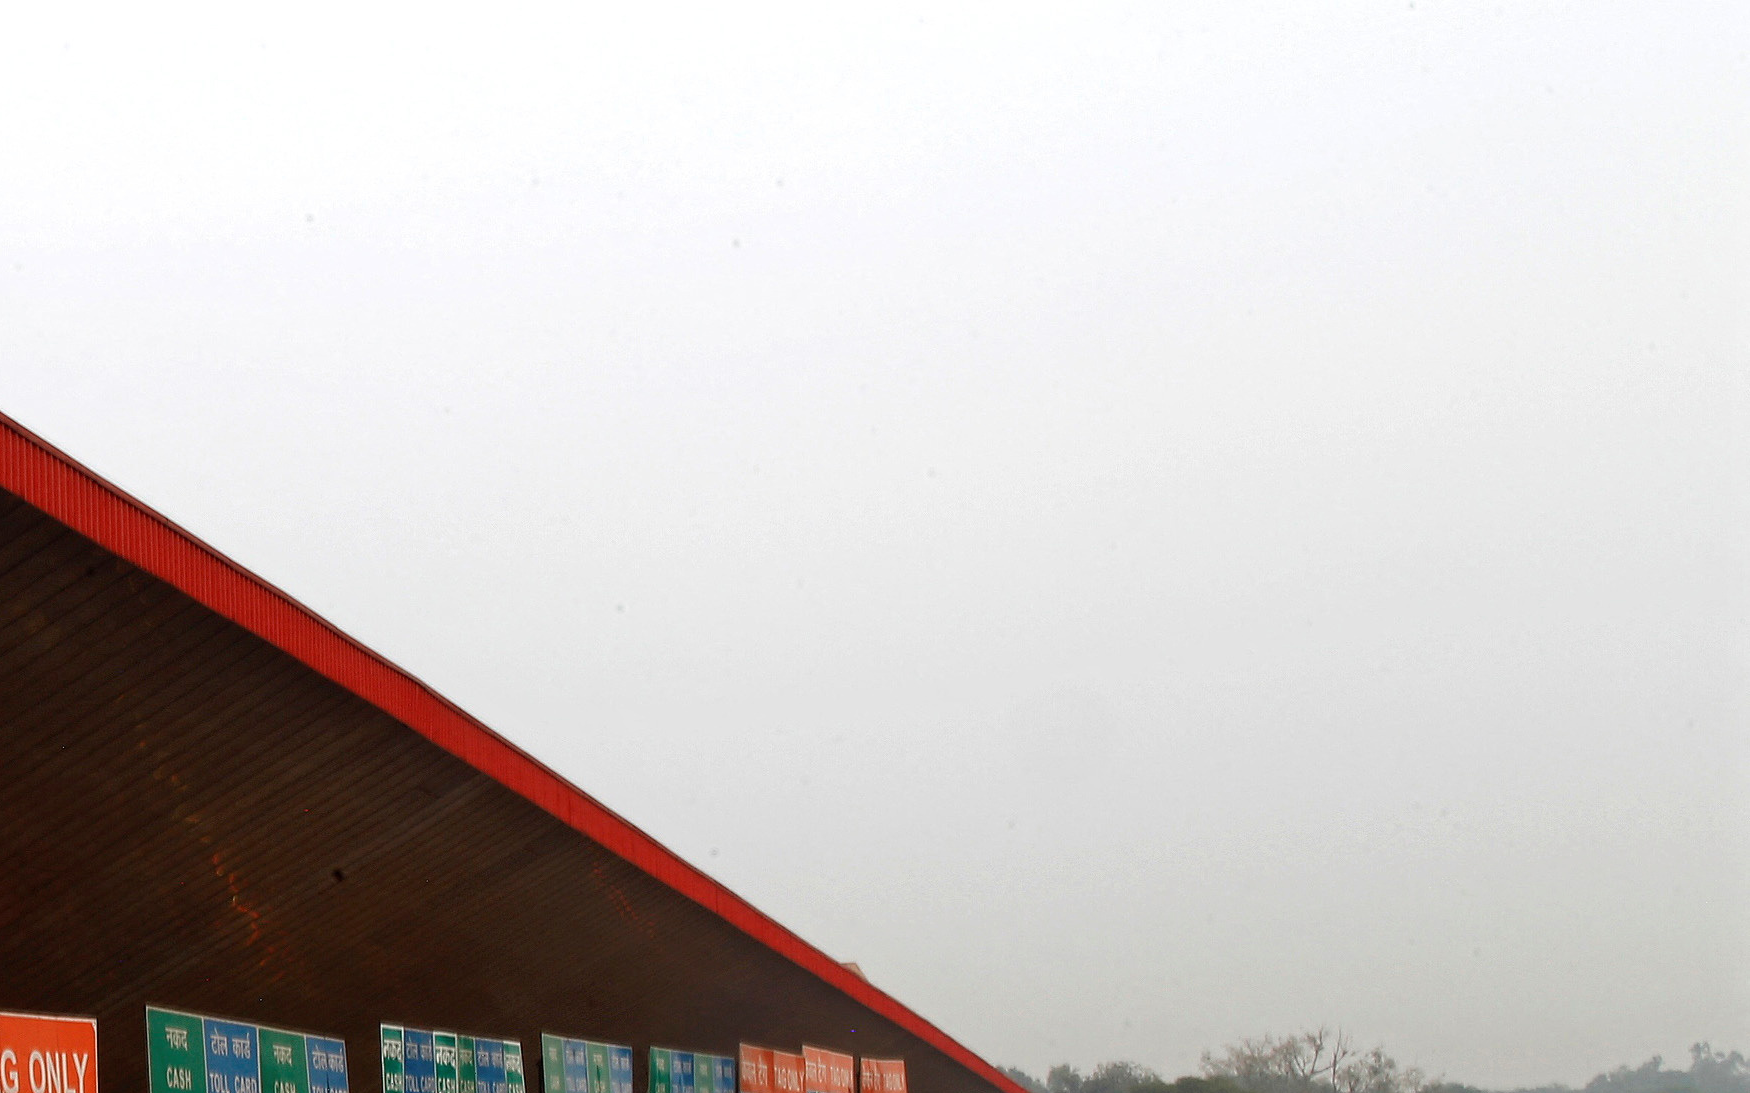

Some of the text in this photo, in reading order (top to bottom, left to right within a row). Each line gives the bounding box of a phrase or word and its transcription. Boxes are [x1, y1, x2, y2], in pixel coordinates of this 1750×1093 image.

[164, 1026, 188, 1051] नकद
[210, 1028, 229, 1057] टोल
[272, 1044, 293, 1067] नकद
[166, 1066, 192, 1091] CASH
[386, 1073, 403, 1091] CASH
[406, 1075, 436, 1093] TOLL CARD
